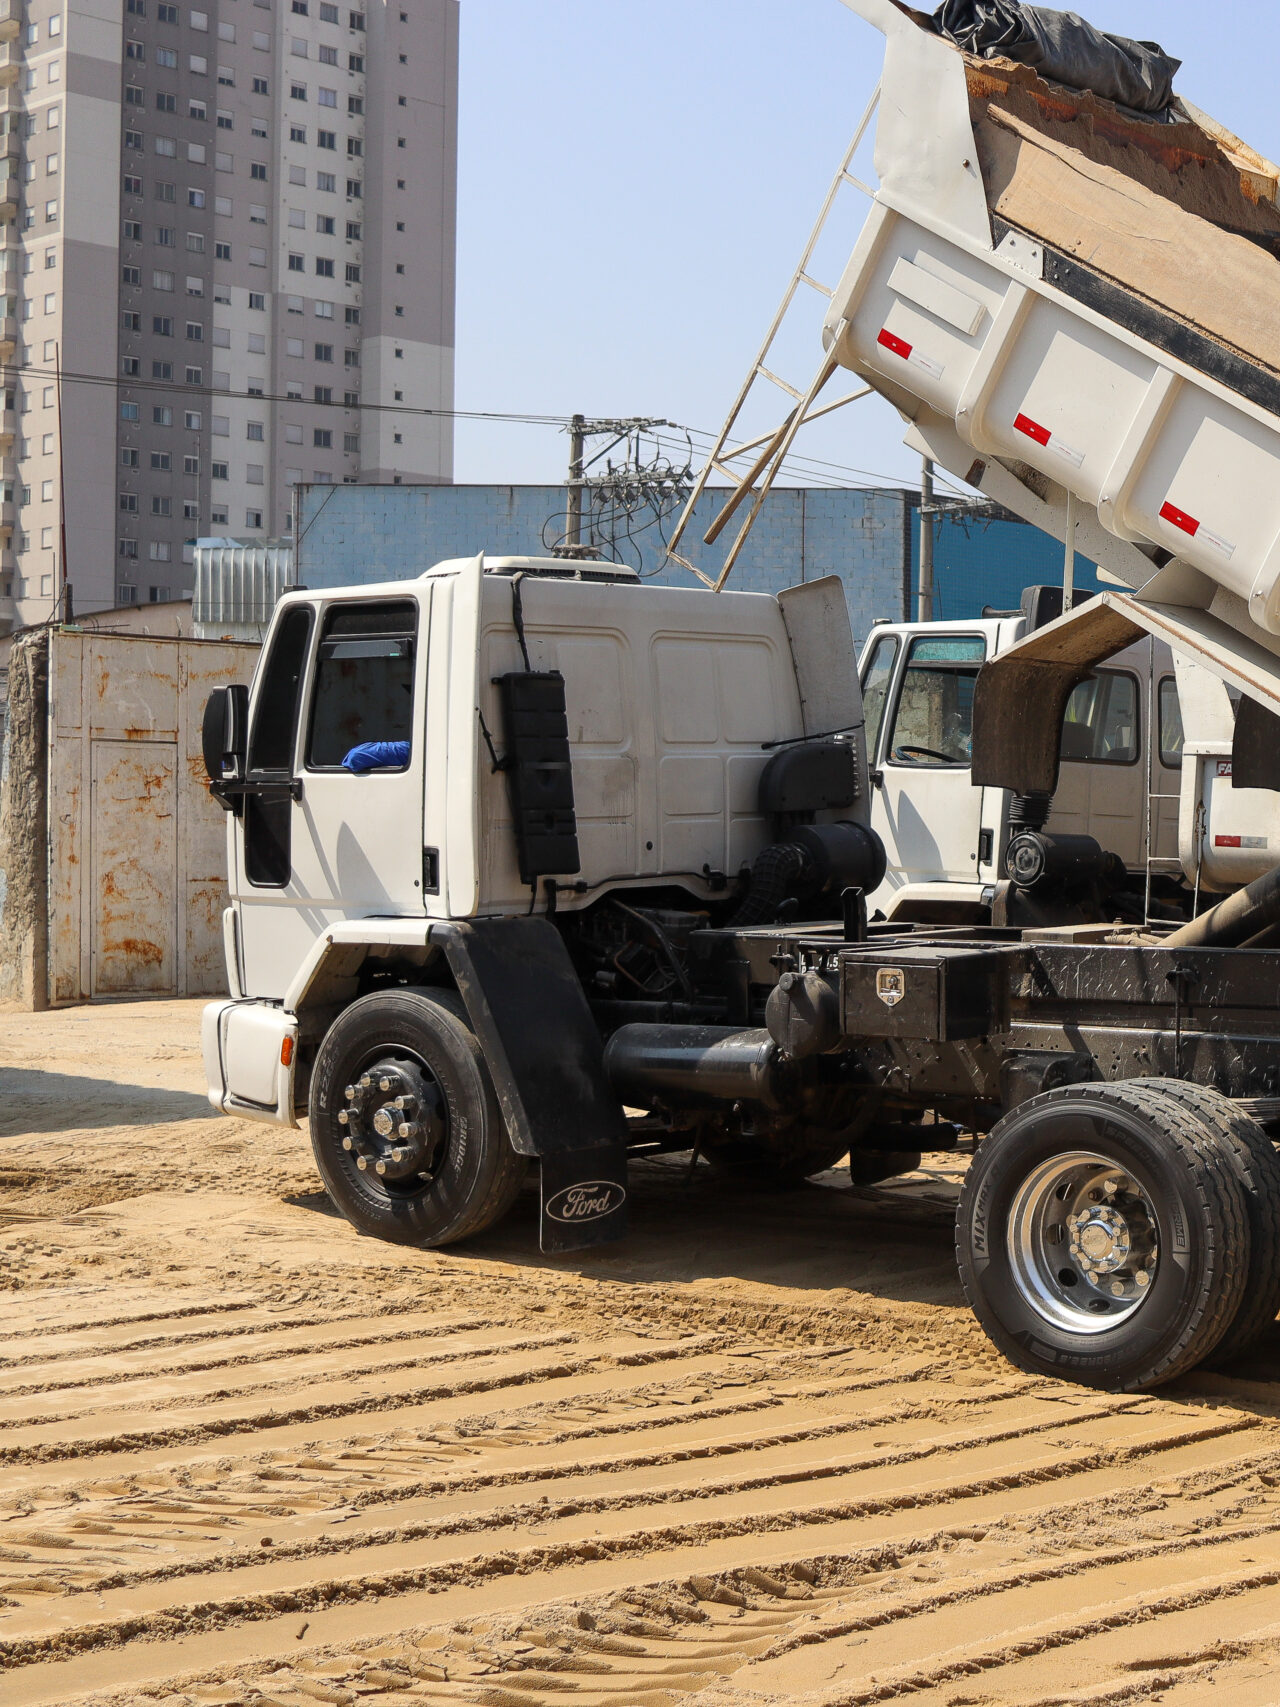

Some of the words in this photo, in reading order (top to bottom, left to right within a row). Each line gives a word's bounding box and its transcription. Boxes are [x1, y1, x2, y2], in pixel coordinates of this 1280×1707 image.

[562, 1186, 611, 1218] Ford
[978, 1182, 992, 1214] MAX
[974, 1208, 988, 1253] MIX
